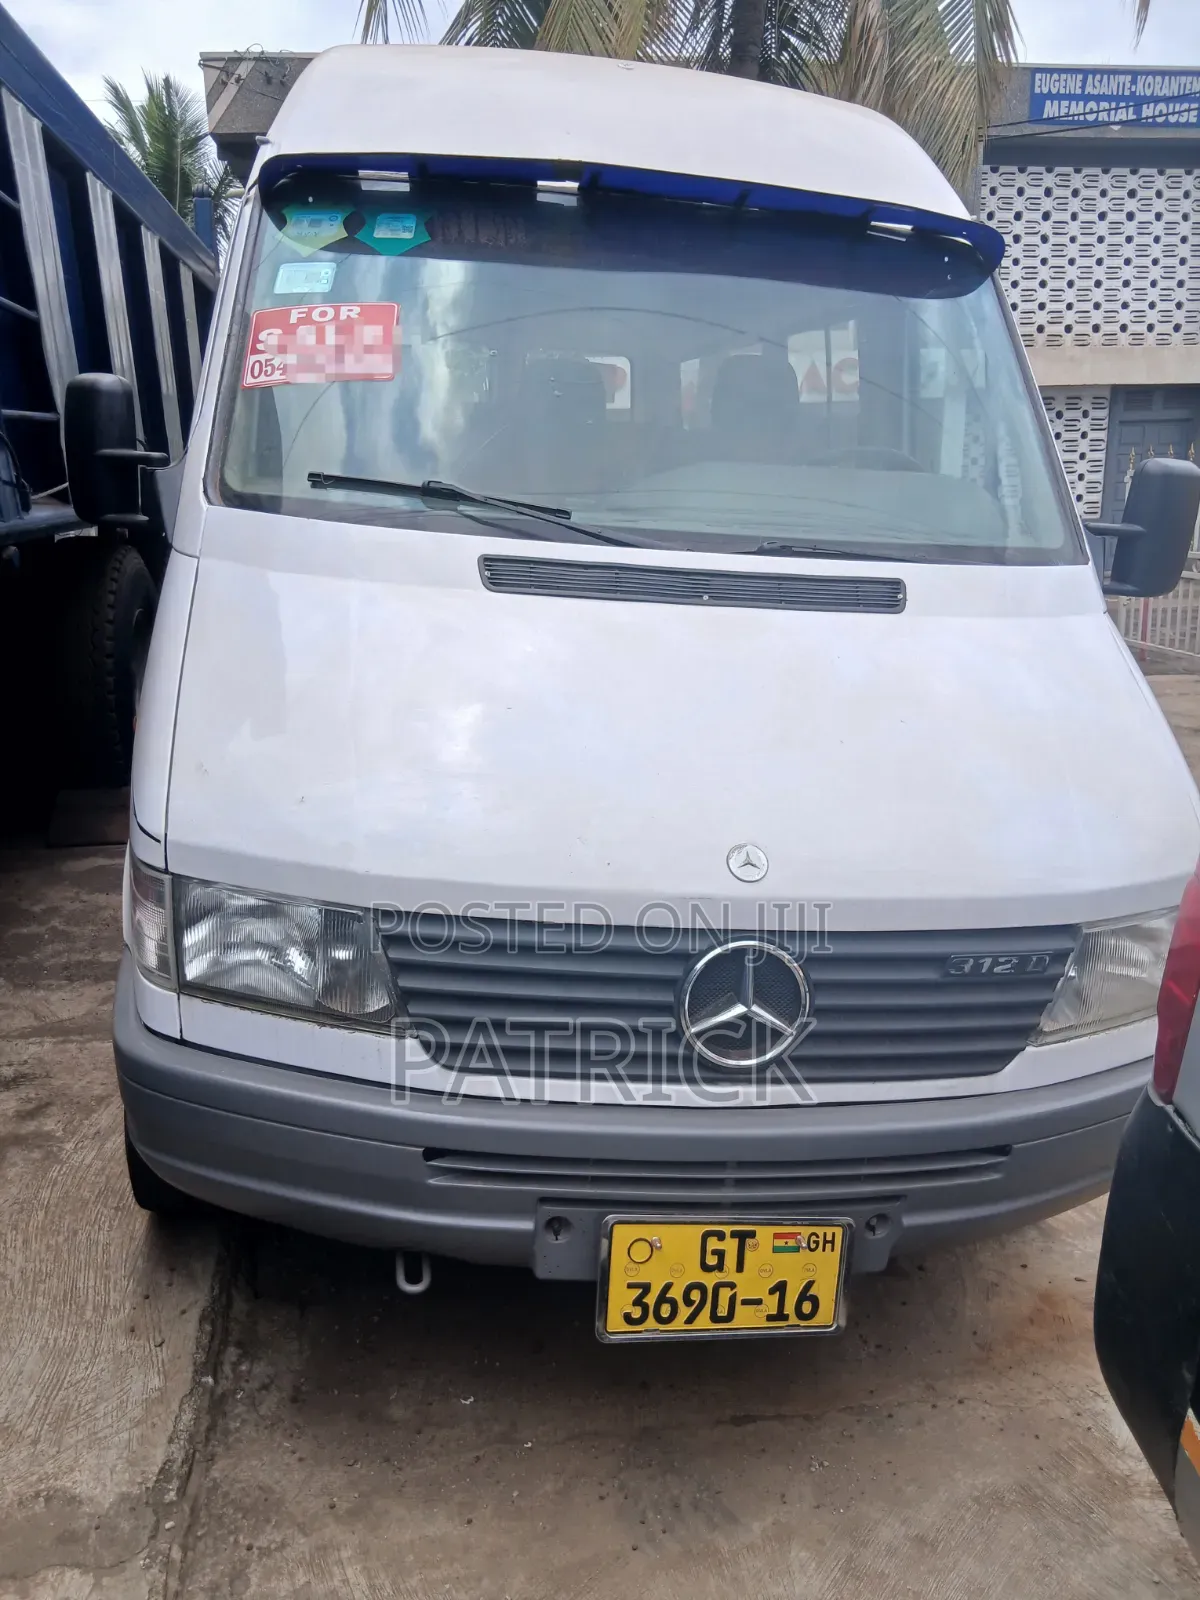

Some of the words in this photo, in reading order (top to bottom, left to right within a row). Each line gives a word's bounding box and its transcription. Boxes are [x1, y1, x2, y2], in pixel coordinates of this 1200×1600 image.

[1034, 73, 1083, 95] EUGENE
[1043, 100, 1137, 122] MEMORIAL
[1141, 102, 1199, 123] HOUSE
[289, 306, 361, 324] FOR
[948, 957, 1019, 975] 312
[1025, 955, 1050, 973] D
[700, 1229, 757, 1273] GT
[806, 1231, 836, 1252] GH
[622, 1280, 820, 1326] 3690-16
